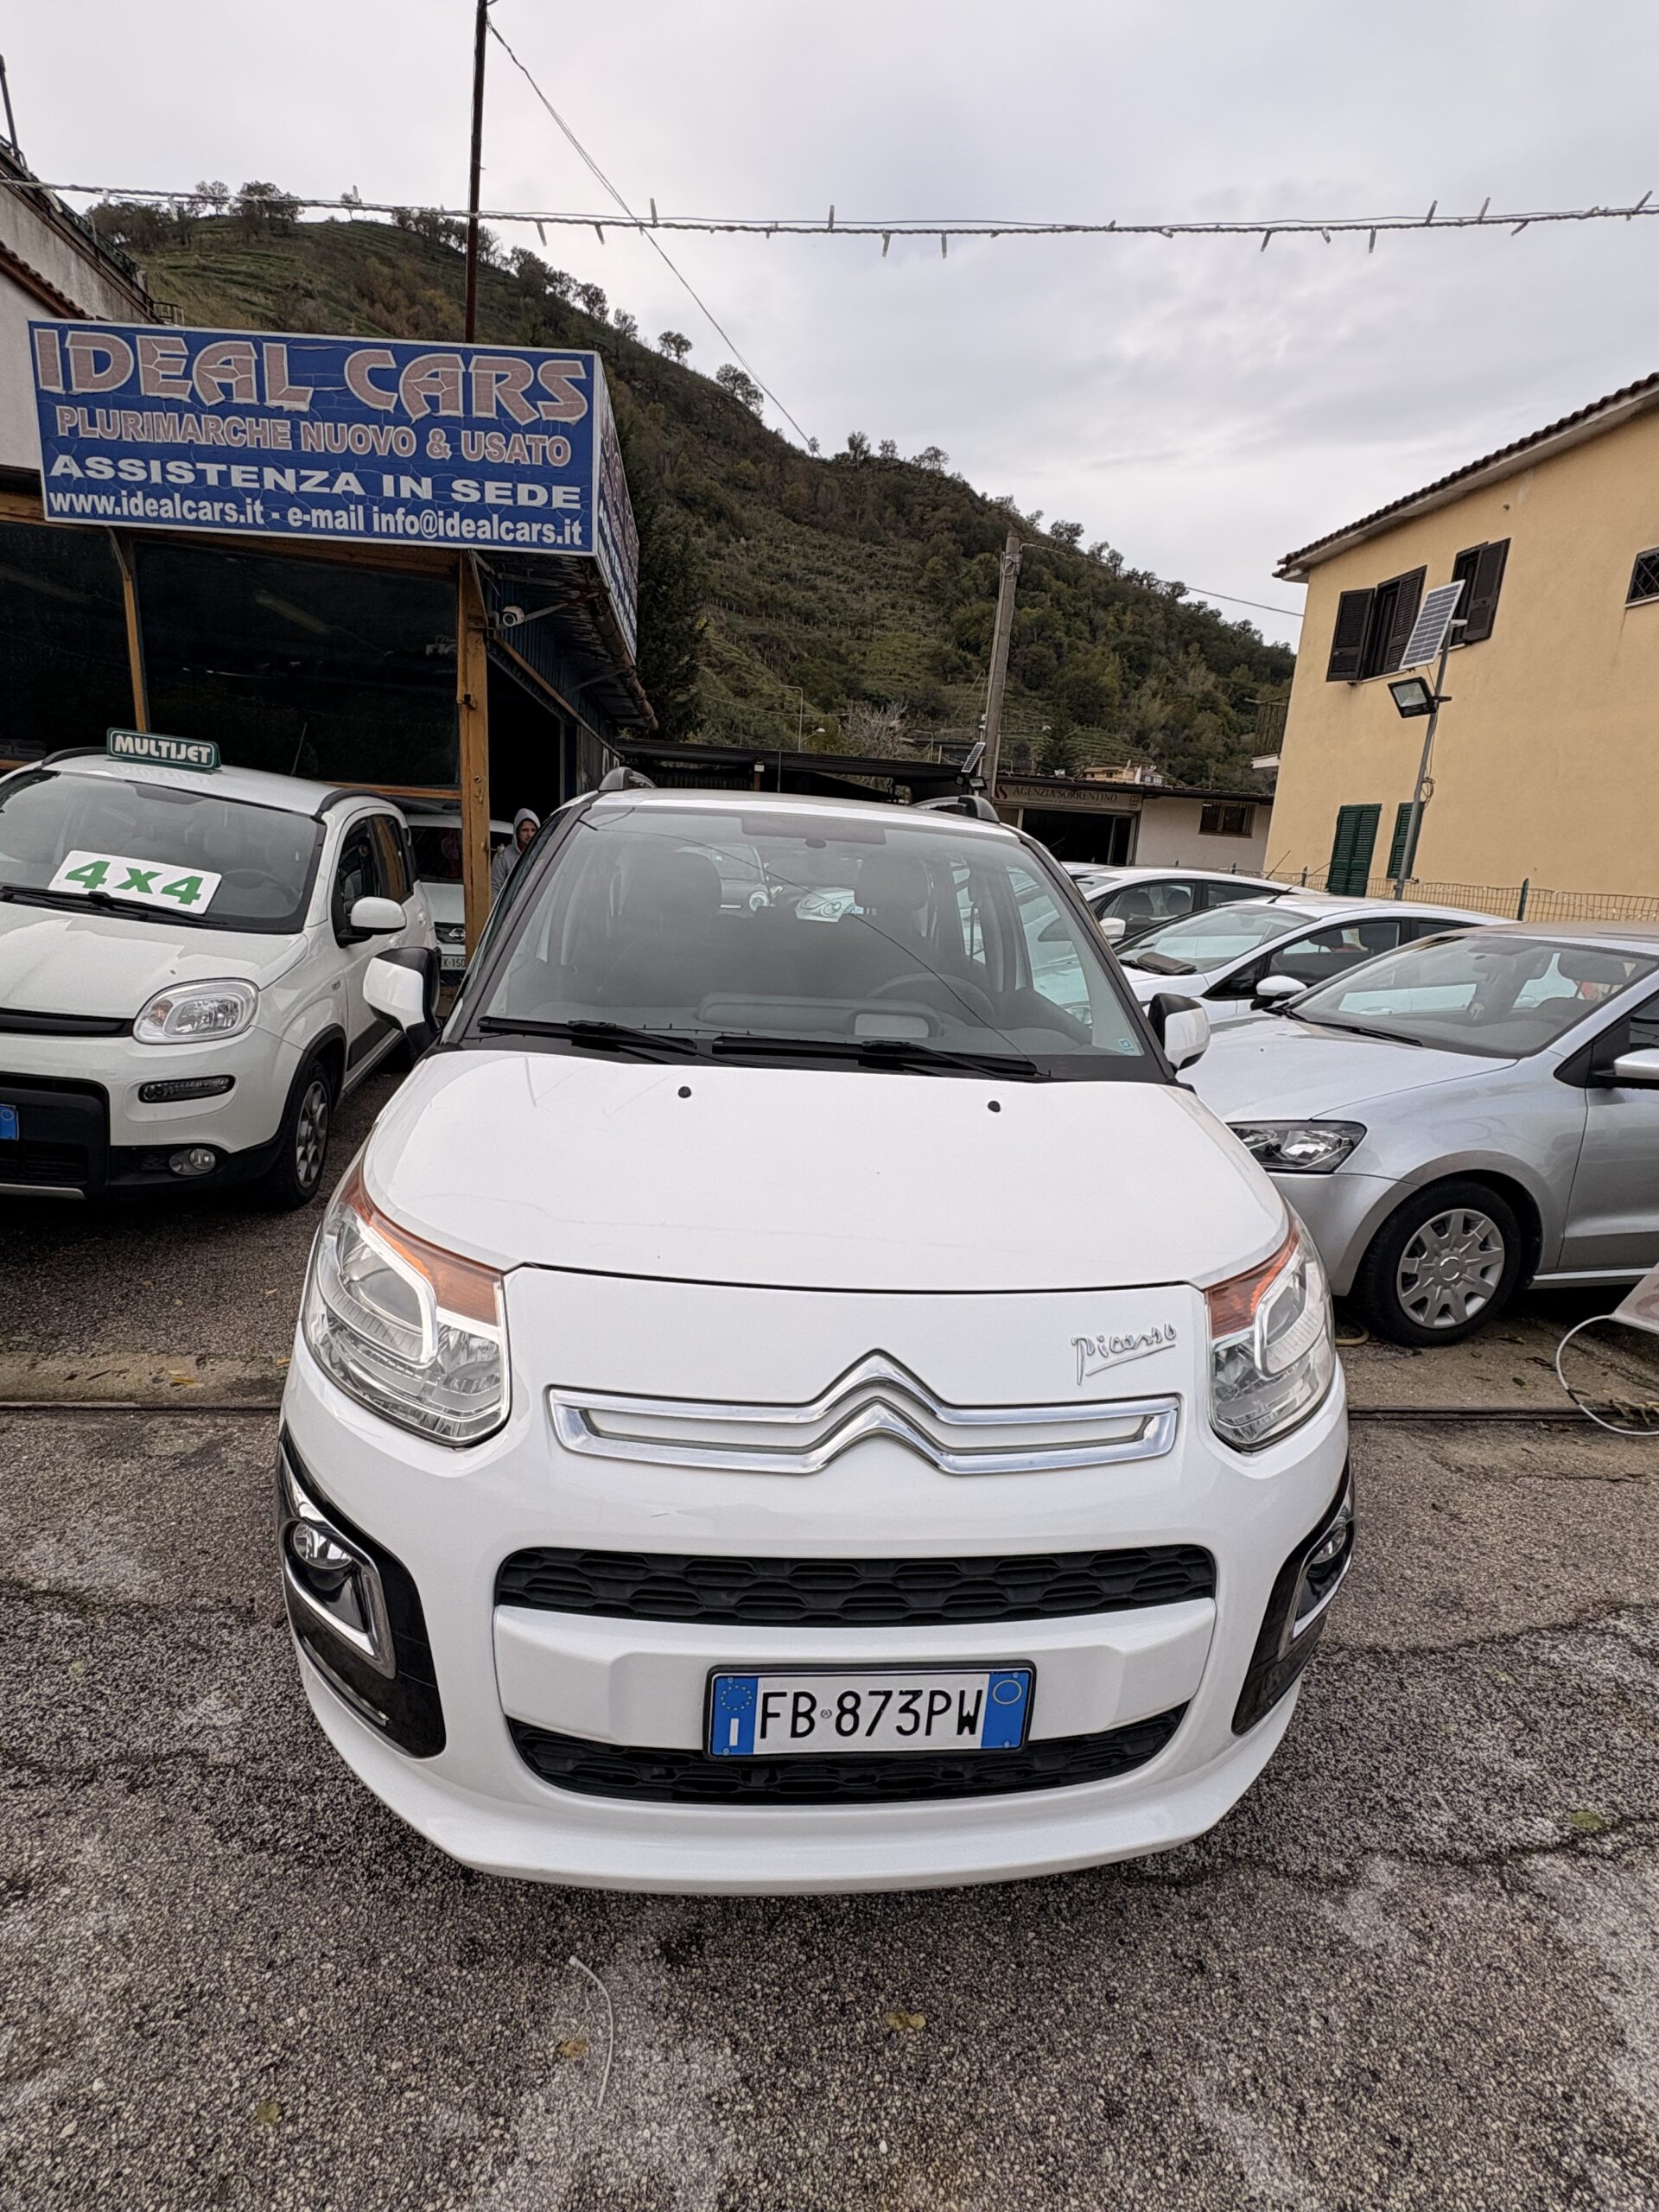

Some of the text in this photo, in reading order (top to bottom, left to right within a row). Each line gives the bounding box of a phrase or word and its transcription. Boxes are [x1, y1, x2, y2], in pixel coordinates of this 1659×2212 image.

[34, 328, 588, 425] IDEAL CARS
[55, 405, 571, 467] PLURIMARCHE NUOVO & USATO
[49, 454, 582, 509] ASSISTENZA IN SEDE
[48, 490, 264, 524] www.idealcars.it
[287, 505, 365, 532] e-mail
[372, 506, 582, 545] info@idealcars.it
[114, 734, 211, 763] MULTIJET
[1013, 786, 1057, 798] AGENZIA
[1058, 789, 1118, 803] SORRENTINO
